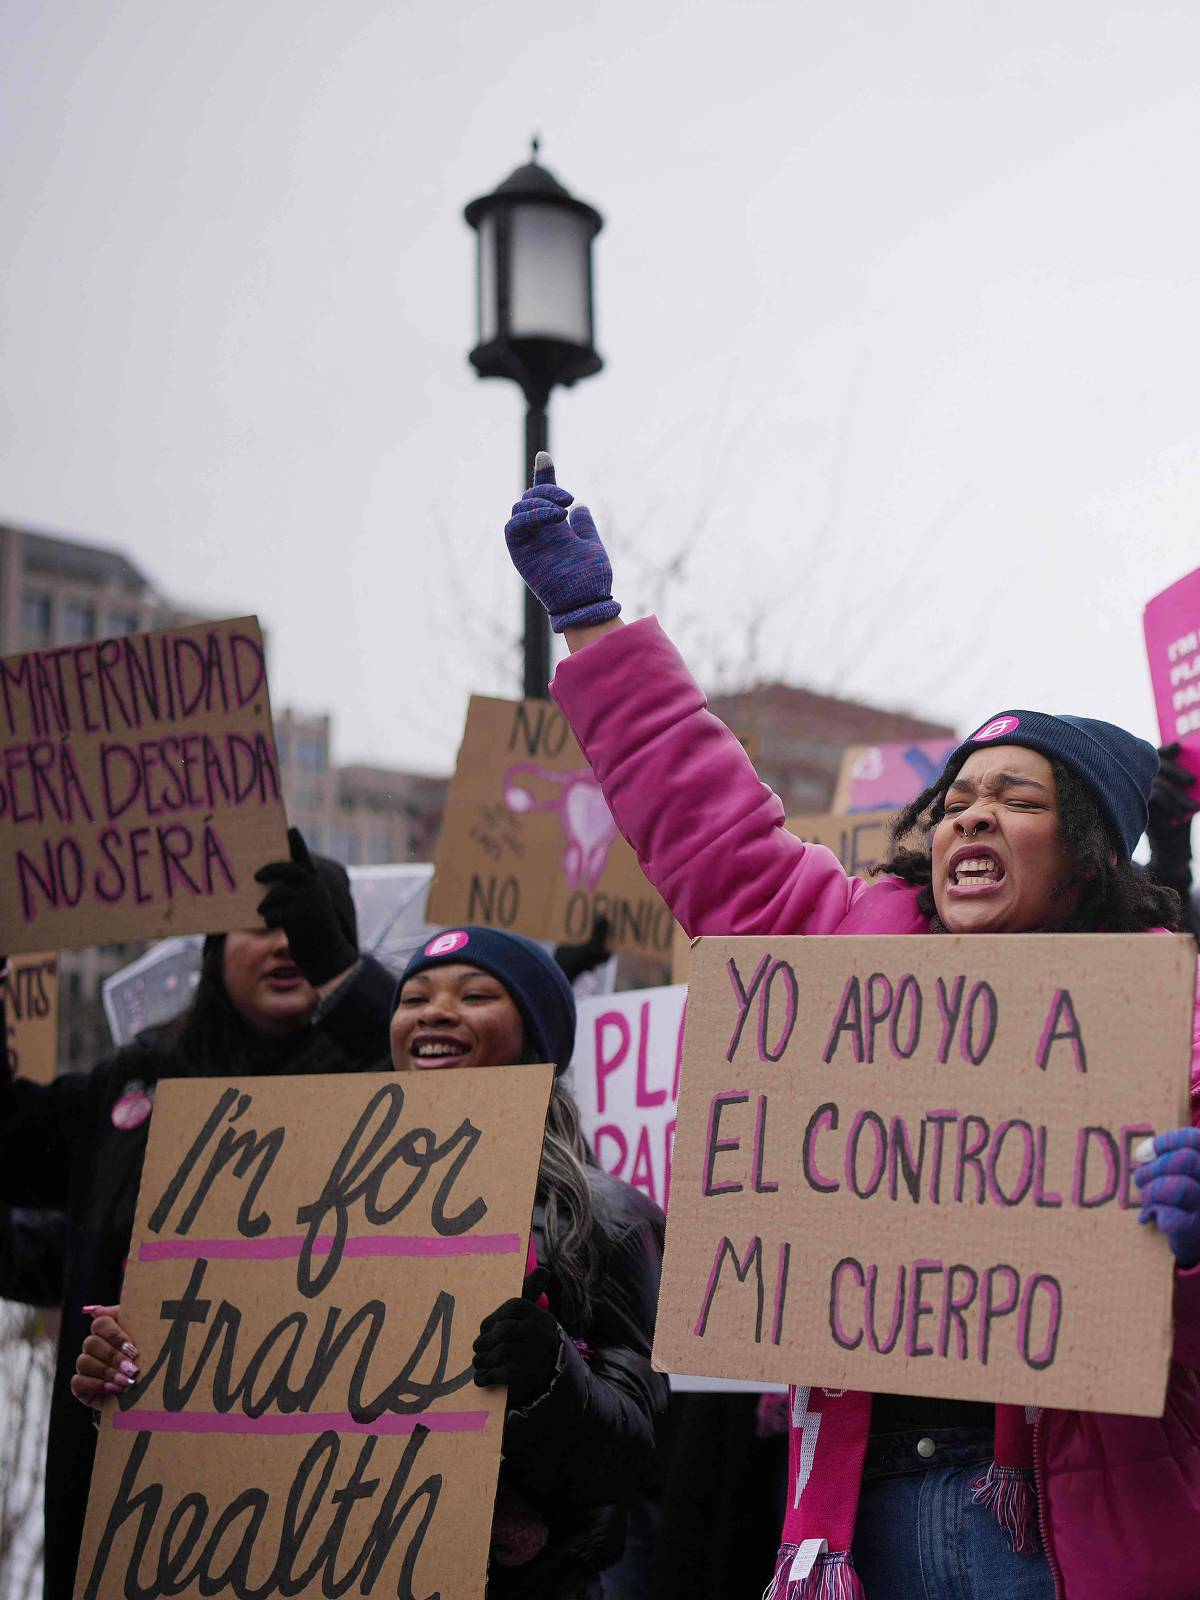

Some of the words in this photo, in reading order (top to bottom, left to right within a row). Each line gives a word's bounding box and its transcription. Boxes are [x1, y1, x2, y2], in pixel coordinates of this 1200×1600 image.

[1168, 631, 1198, 662] I'M
[100, 729, 282, 820] DESEADA
[510, 703, 569, 759] NO
[16, 832, 84, 923] NO
[94, 814, 236, 903] SERÁ
[468, 873, 520, 926] NO
[727, 953, 799, 1063] YO
[1036, 988, 1087, 1072] A
[148, 1087, 285, 1238] I'm
[296, 1083, 487, 1298] for
[703, 1090, 779, 1196] EL
[802, 1101, 1062, 1207] CONTROL
[117, 1259, 474, 1424] trans
[694, 1236, 790, 1344] MI
[829, 1256, 1062, 1370] CUERPO
[85, 1423, 442, 1600] health
